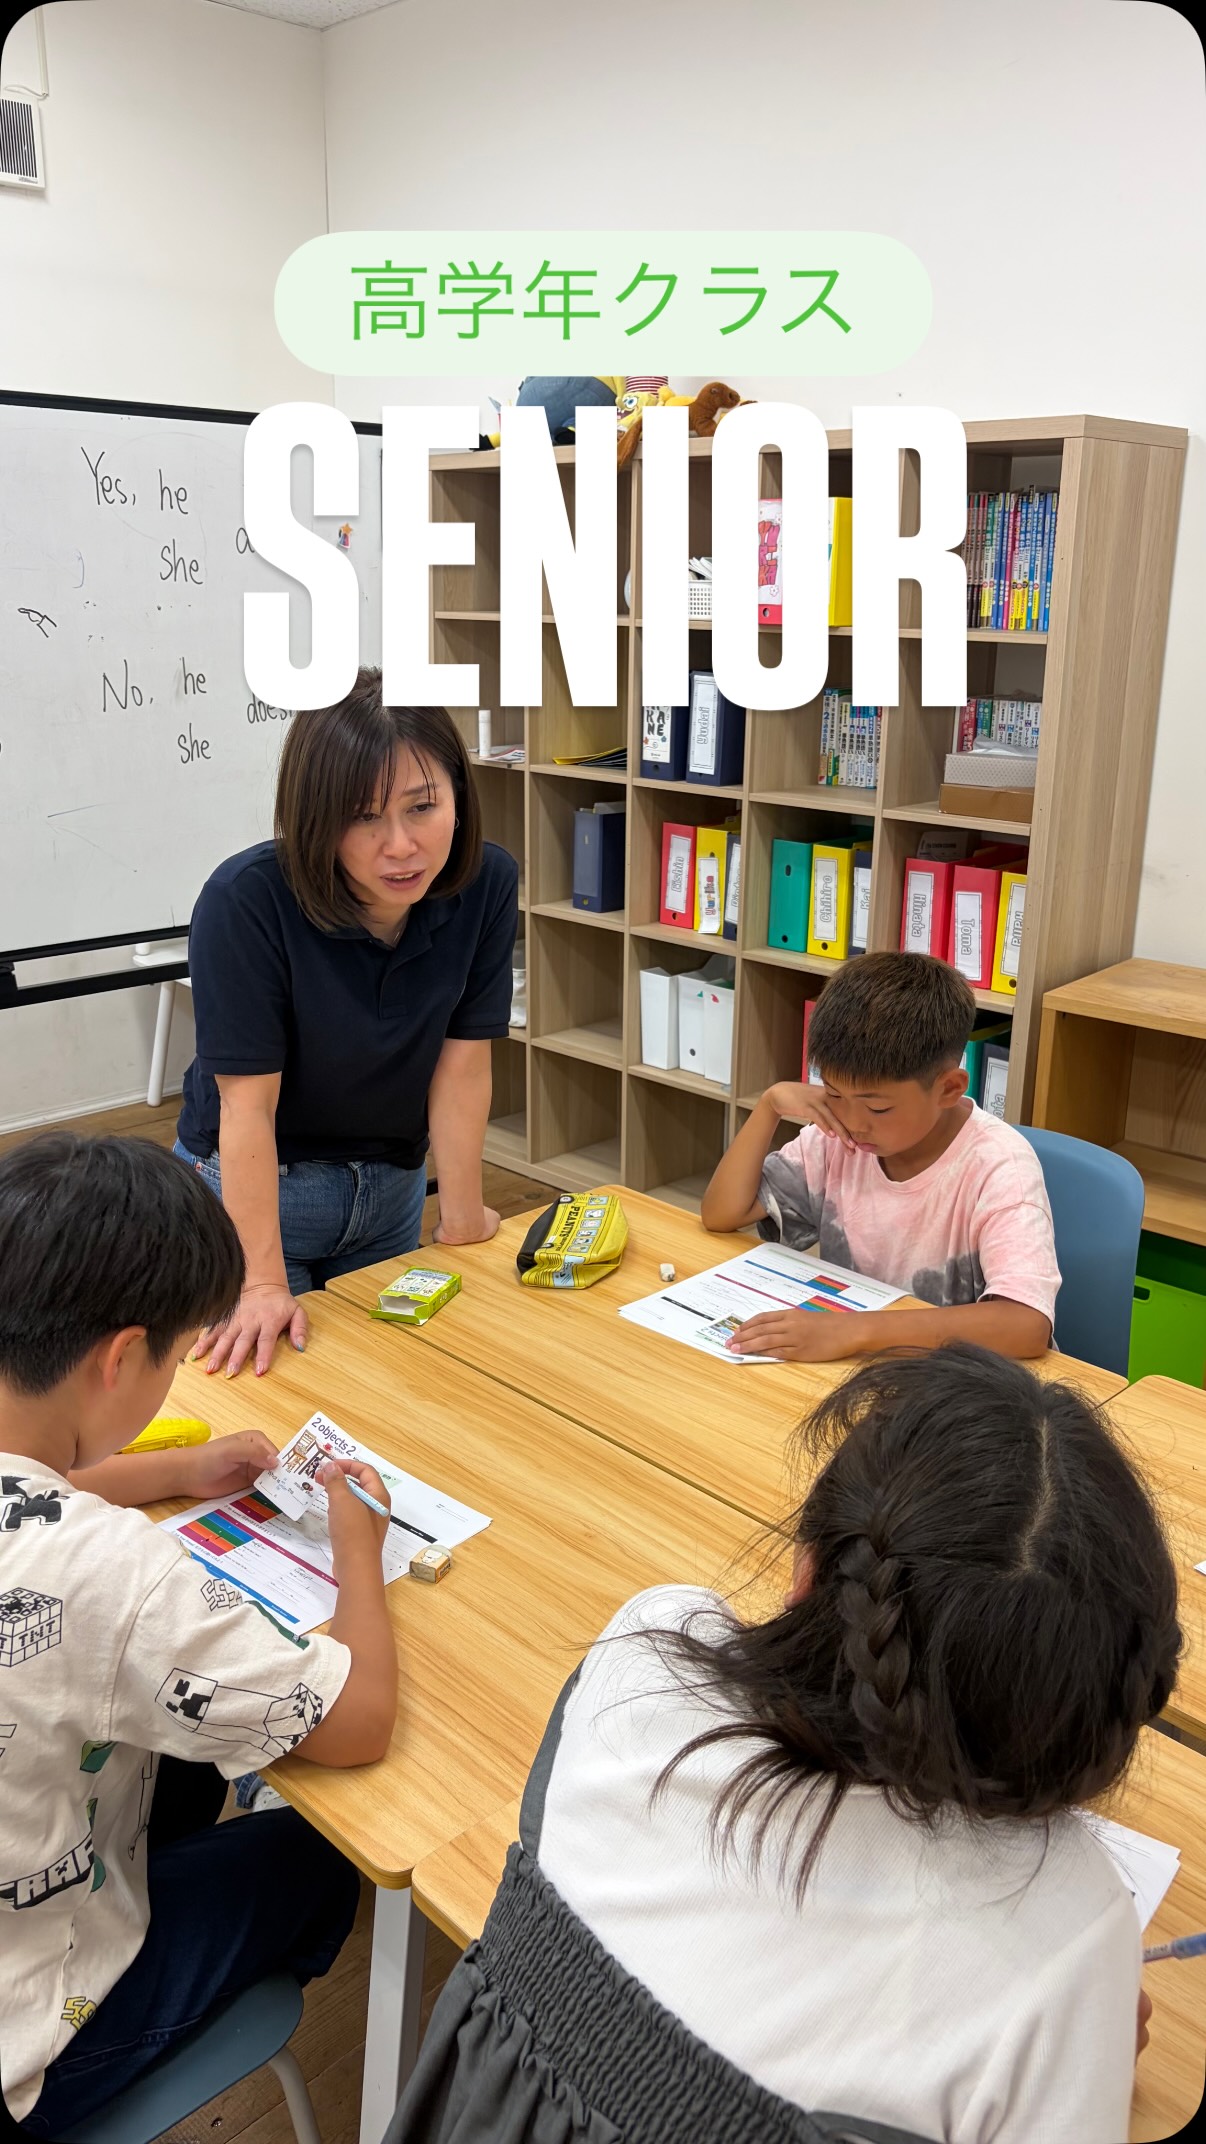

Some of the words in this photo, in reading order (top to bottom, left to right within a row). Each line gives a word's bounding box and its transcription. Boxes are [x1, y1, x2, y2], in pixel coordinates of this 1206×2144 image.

[81, 446, 136, 506] Yes,
[159, 468, 189, 515] he
[102, 659, 154, 713] No,
[180, 656, 207, 696] he
[696, 706, 710, 745] Yudai
[820, 875, 834, 923] Chihiro
[912, 893, 927, 938] Hinata
[961, 918, 975, 956] Toma
[558, 1205, 580, 1238] PEANUTS
[311, 1417, 322, 1429] 2
[318, 1424, 348, 1451] objects
[346, 1445, 357, 1457] 2
[18, 1619, 55, 1647] TNT
